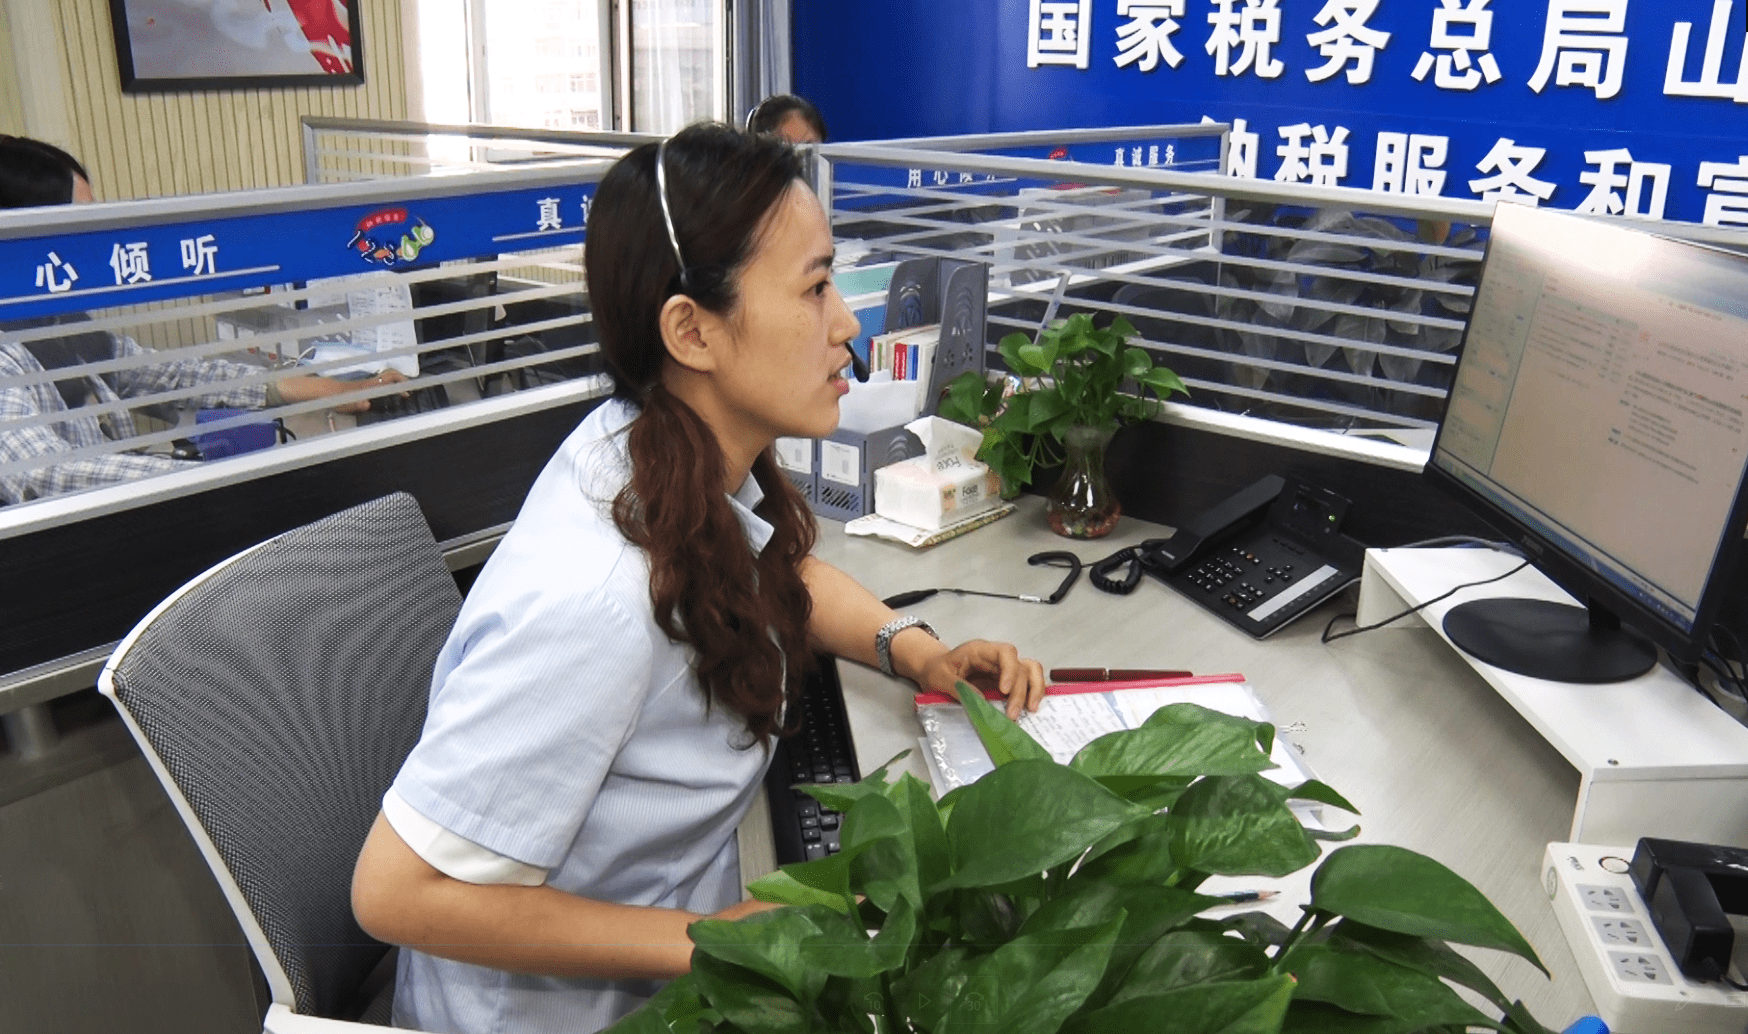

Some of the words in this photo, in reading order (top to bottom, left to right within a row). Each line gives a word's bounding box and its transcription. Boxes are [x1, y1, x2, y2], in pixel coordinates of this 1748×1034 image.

[1027, 0, 1748, 104] 国家税务总局山
[35, 234, 218, 293] 心倾听
